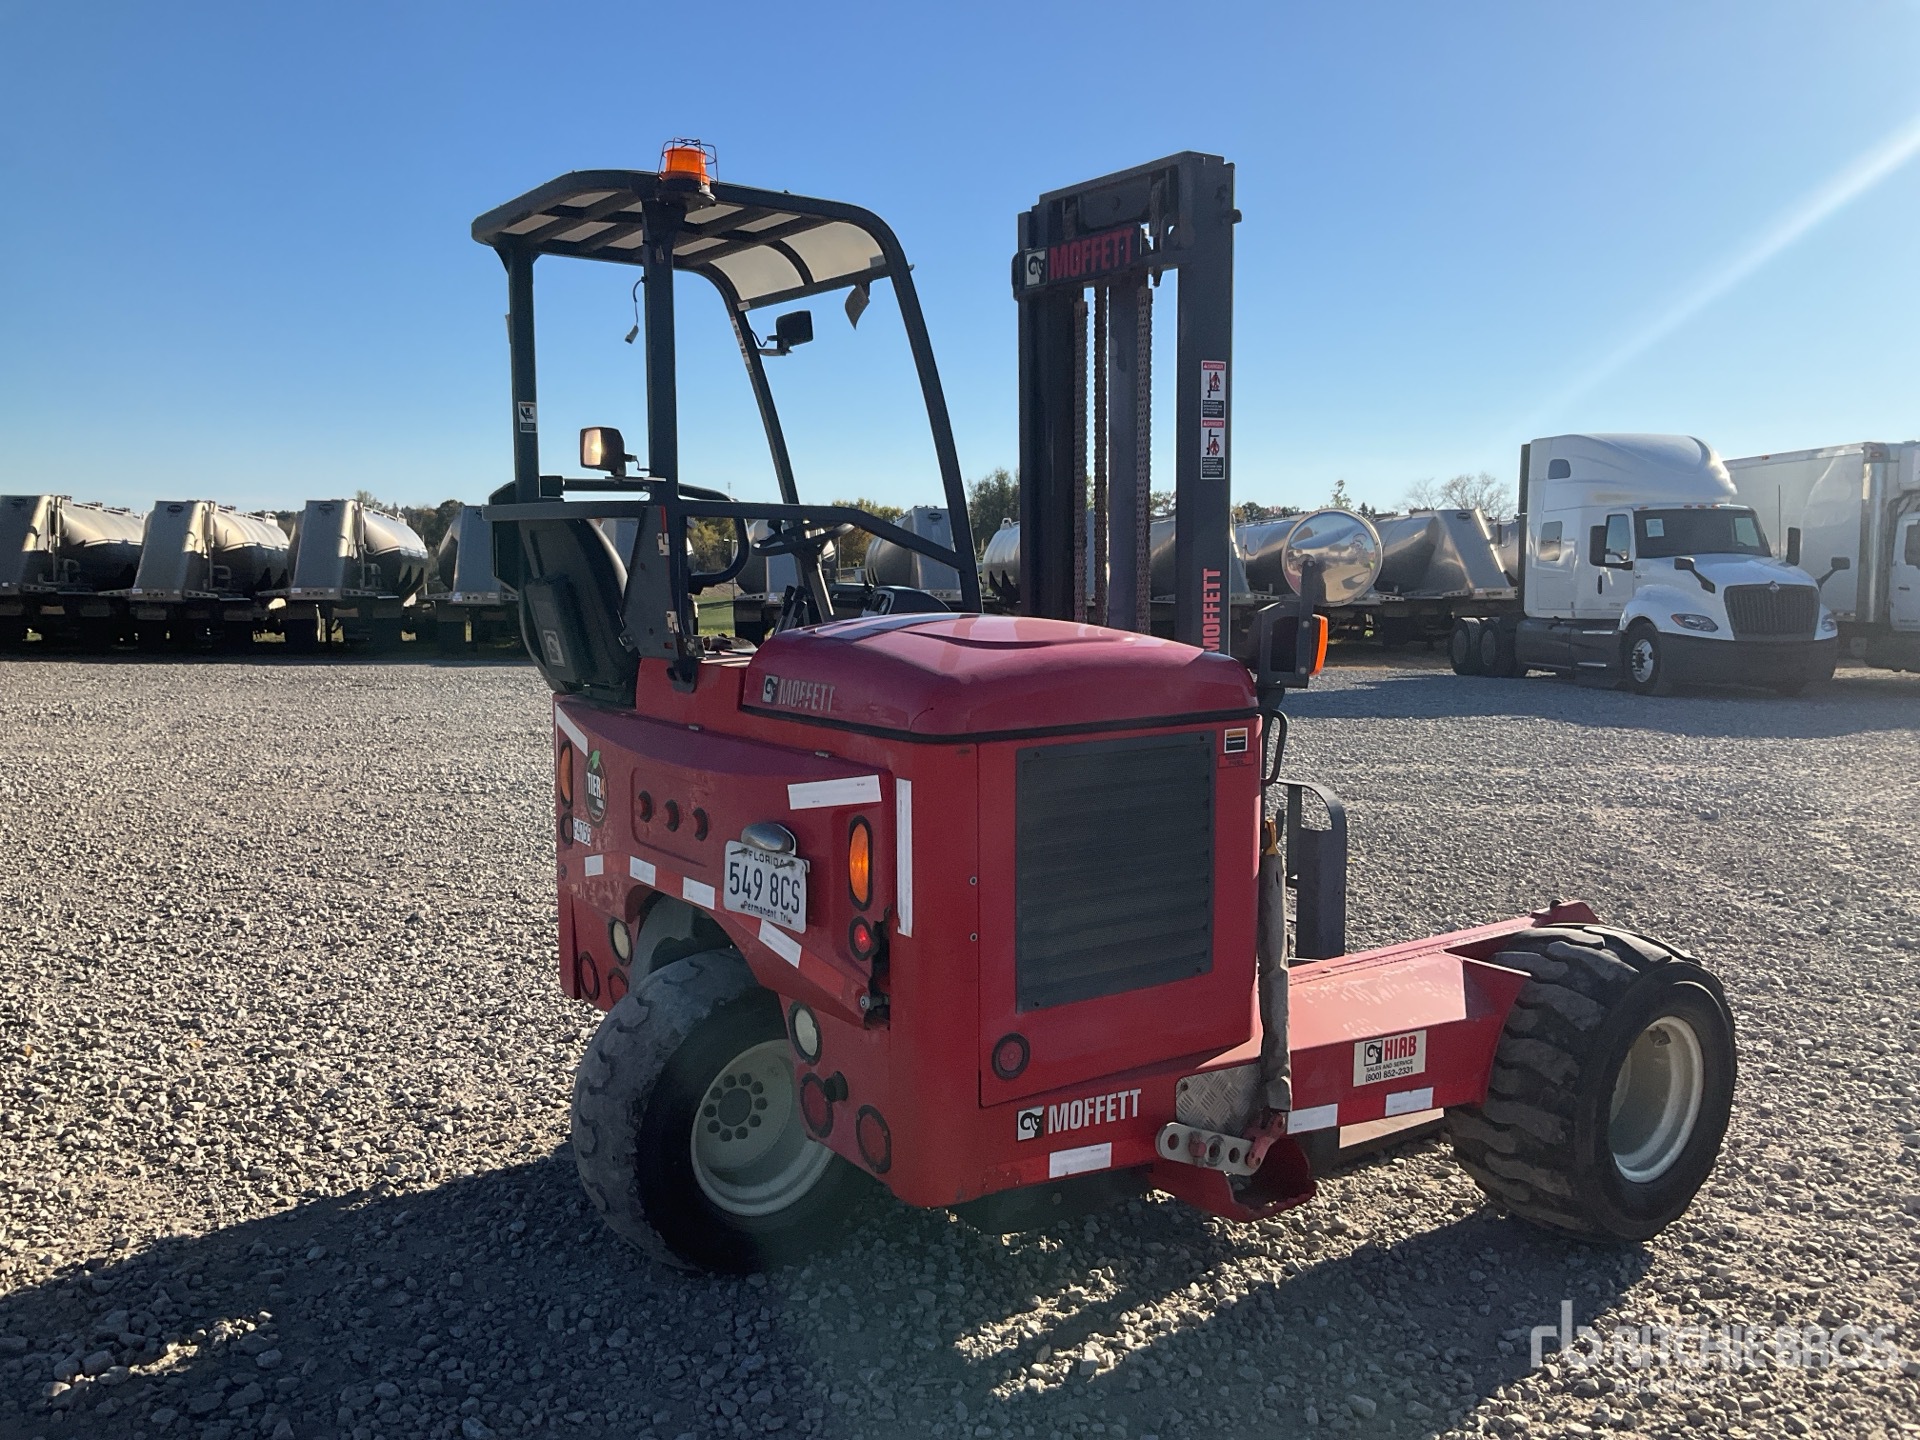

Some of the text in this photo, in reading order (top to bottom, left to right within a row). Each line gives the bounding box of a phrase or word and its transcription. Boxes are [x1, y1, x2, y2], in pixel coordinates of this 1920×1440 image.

[1050, 227, 1134, 279] MOFFETT
[1203, 568, 1220, 653] MOFFETT
[778, 679, 836, 713] MOFFETT
[748, 850, 785, 868] FLORIDA
[729, 861, 801, 915] 549 8CS
[743, 900, 777, 920] Permanent
[1384, 1035, 1417, 1061] HIAB
[1365, 1066, 1413, 1083] (800) 852-2331
[1366, 1065, 1382, 1073] SALES
[1393, 1059, 1413, 1067] SERVICE
[1048, 1088, 1142, 1134] MOFFETT
